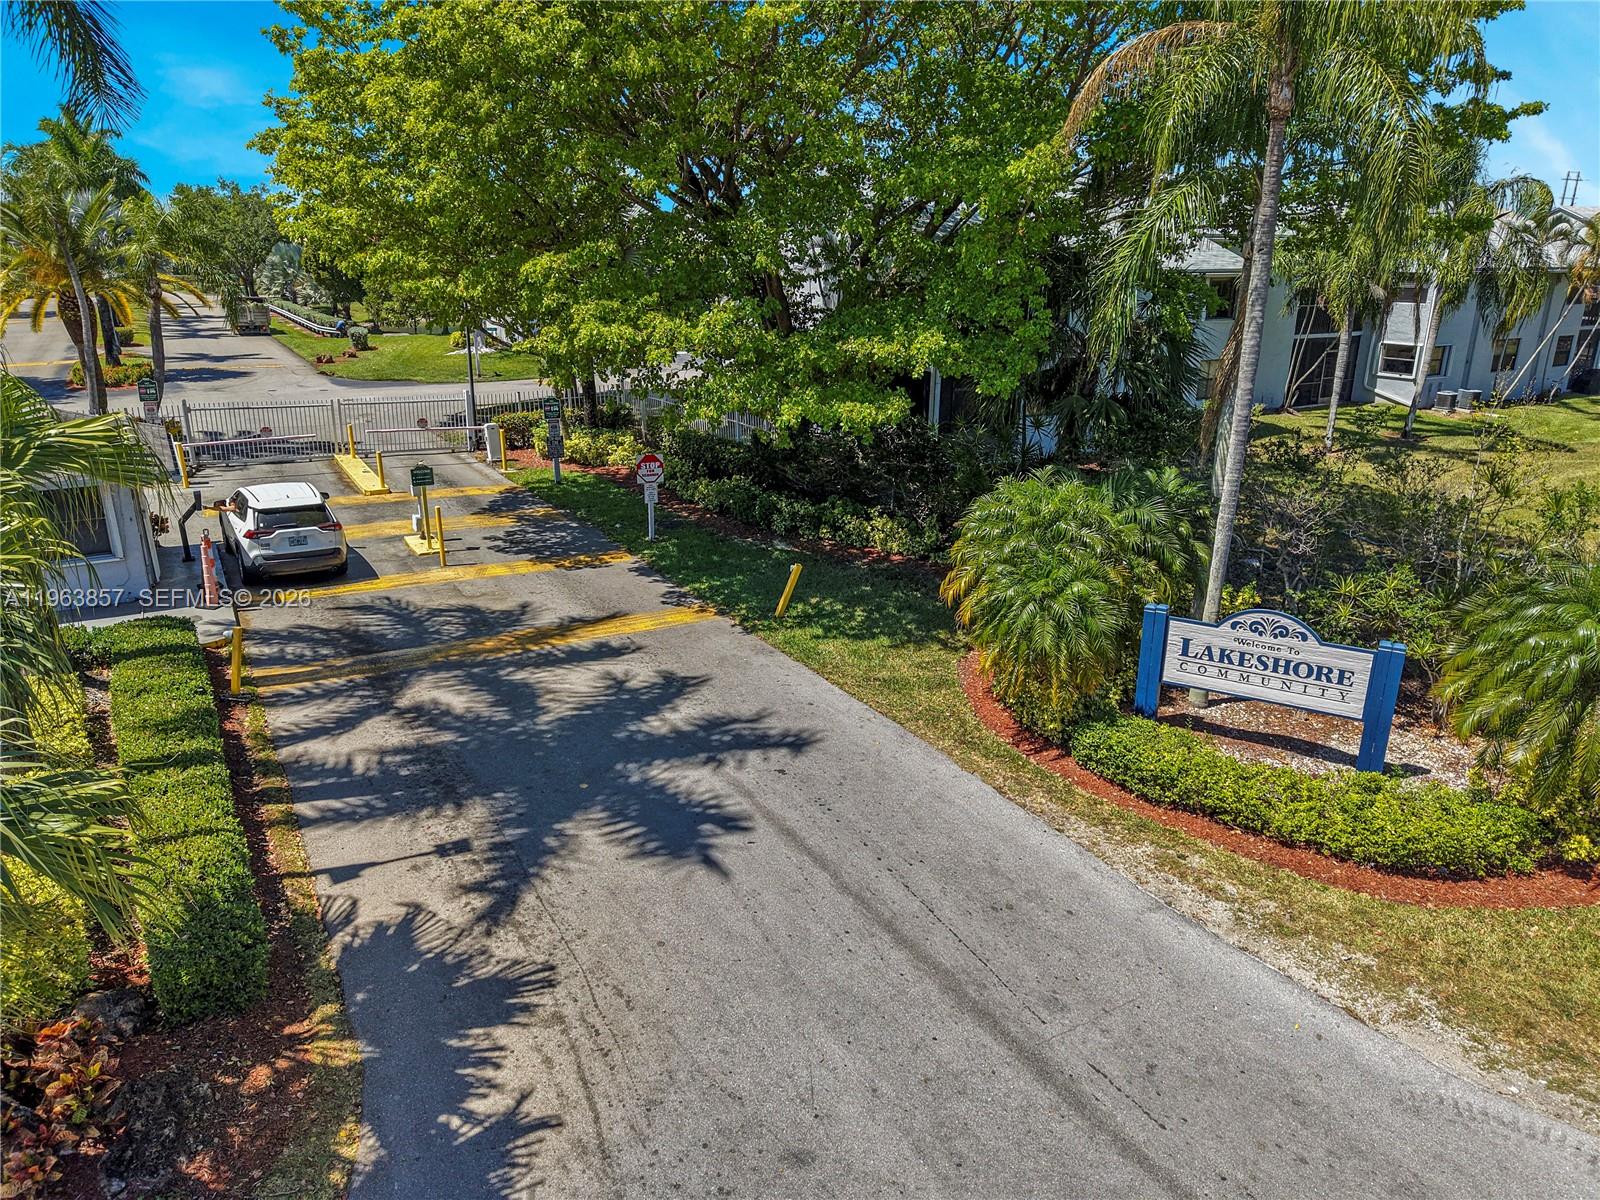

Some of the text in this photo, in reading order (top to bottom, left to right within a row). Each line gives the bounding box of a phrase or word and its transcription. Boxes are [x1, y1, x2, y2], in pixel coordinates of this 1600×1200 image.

[1179, 637, 1355, 687] LAKESHORE
[1233, 637, 1300, 656] Welcome To
[1179, 662, 1349, 701] COMMUNITY
